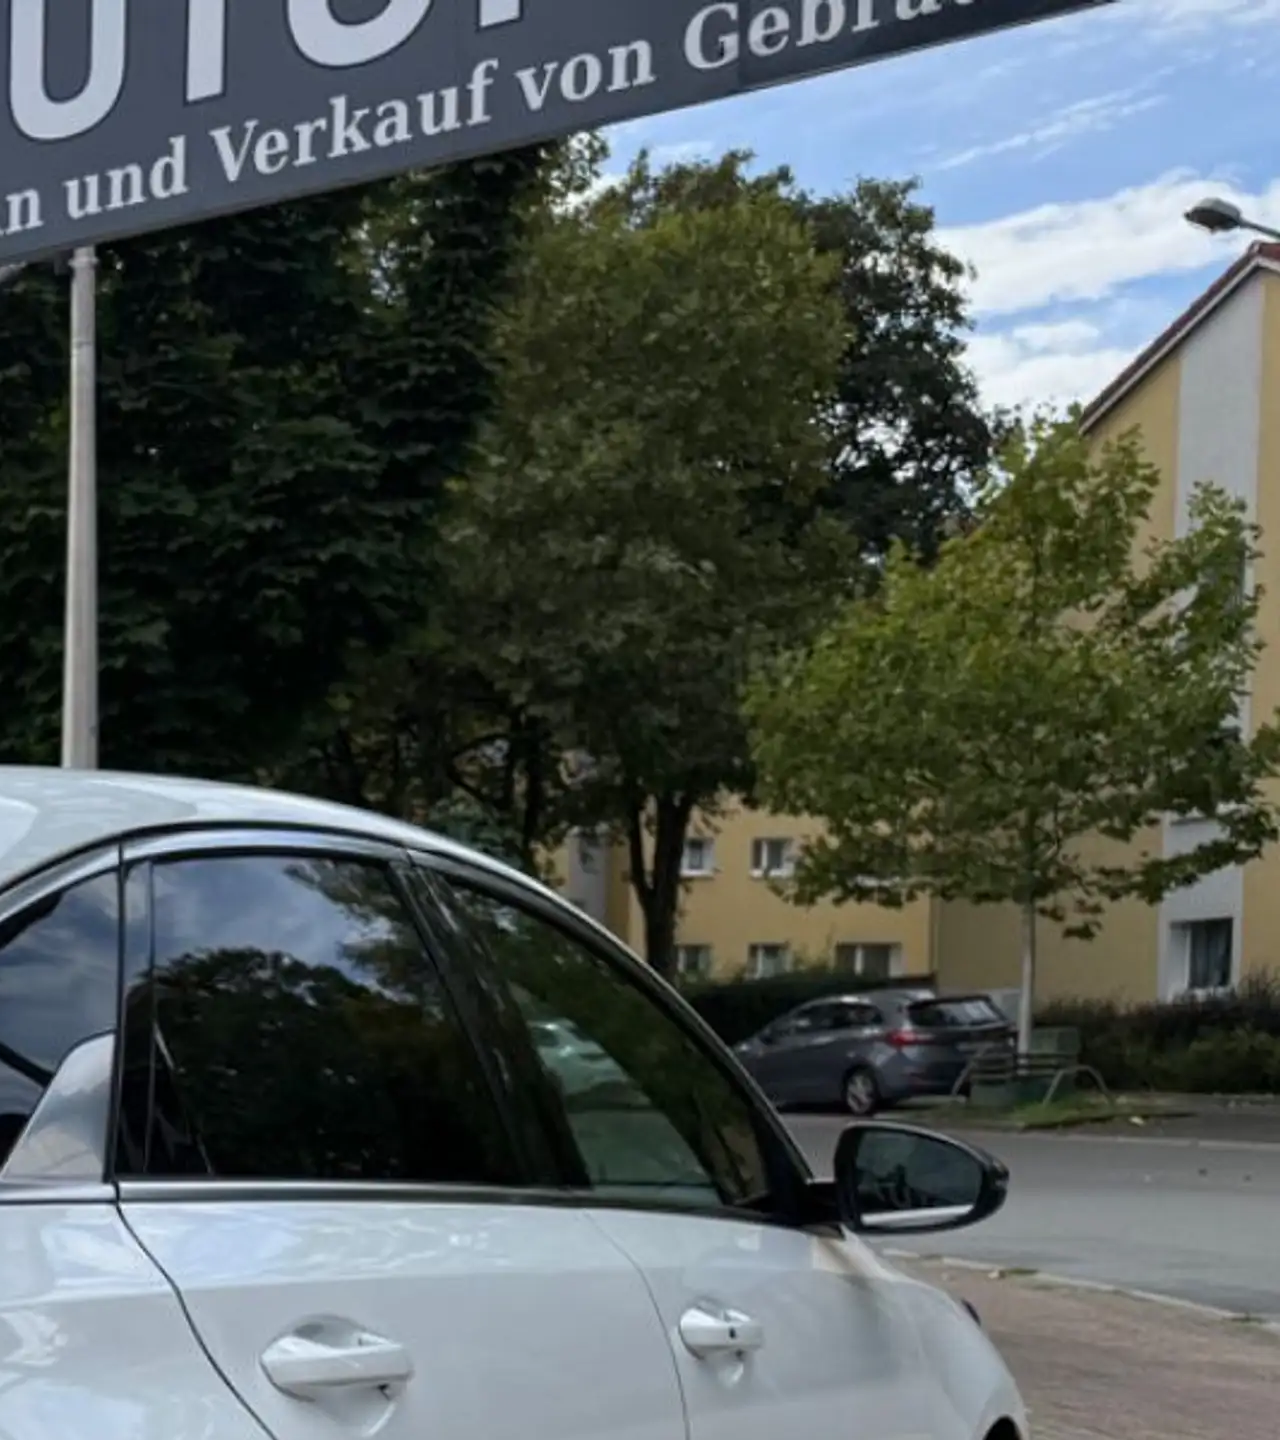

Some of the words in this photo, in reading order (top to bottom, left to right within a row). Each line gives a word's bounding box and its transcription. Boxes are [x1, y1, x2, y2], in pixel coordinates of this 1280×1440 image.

[63, 138, 188, 221] und
[209, 58, 500, 184] Verkauf
[515, 37, 654, 114] von
